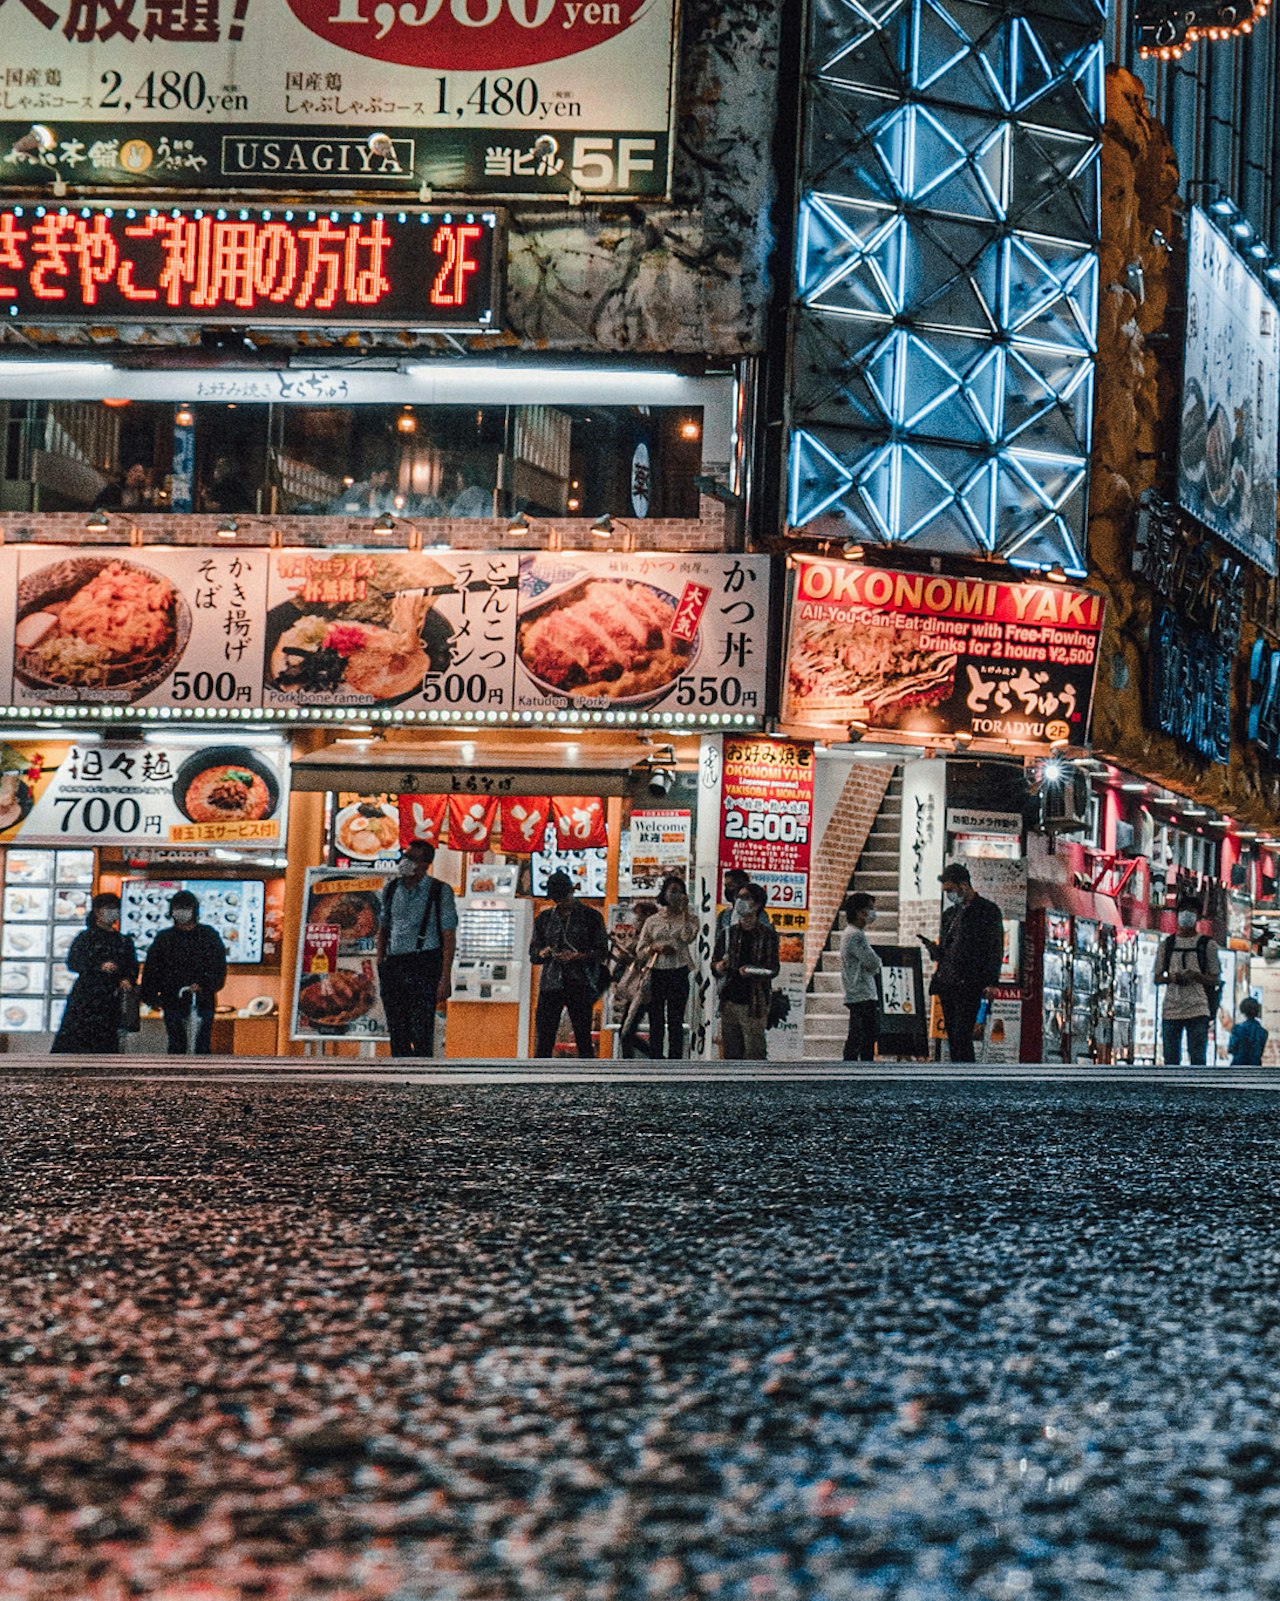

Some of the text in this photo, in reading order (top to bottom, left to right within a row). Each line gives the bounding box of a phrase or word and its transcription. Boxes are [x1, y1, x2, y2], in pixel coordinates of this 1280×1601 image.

[562, 0, 621, 29] yen
[285, 71, 343, 93] 国産鶏
[236, 141, 403, 171] USAGIYA
[570, 136, 656, 189] 5F
[430, 224, 482, 305] 2F
[195, 557, 222, 610] そば
[802, 564, 1100, 627] OKONOMI YAKI
[223, 556, 252, 663] かき揚げ
[446, 562, 475, 667] ラーメン
[479, 561, 509, 669] とんこつ
[674, 586, 704, 638] 大人気
[718, 560, 757, 668] かつ丼
[801, 603, 1097, 649] All-You-Can-Eat dinner with Free-Flowing
[918, 633, 1095, 666] Drinks for 2 hours ¥2,500
[171, 671, 252, 703] 500円
[269, 691, 374, 704] Pork bone ramen
[422, 672, 504, 705] 500円
[518, 695, 569, 708] Katudon
[676, 676, 758, 709] 550円
[971, 717, 1068, 738] TORADYU 2F
[726, 743, 813, 767] お好み焼き
[53, 795, 163, 835] 700円
[633, 819, 688, 833] Welcome
